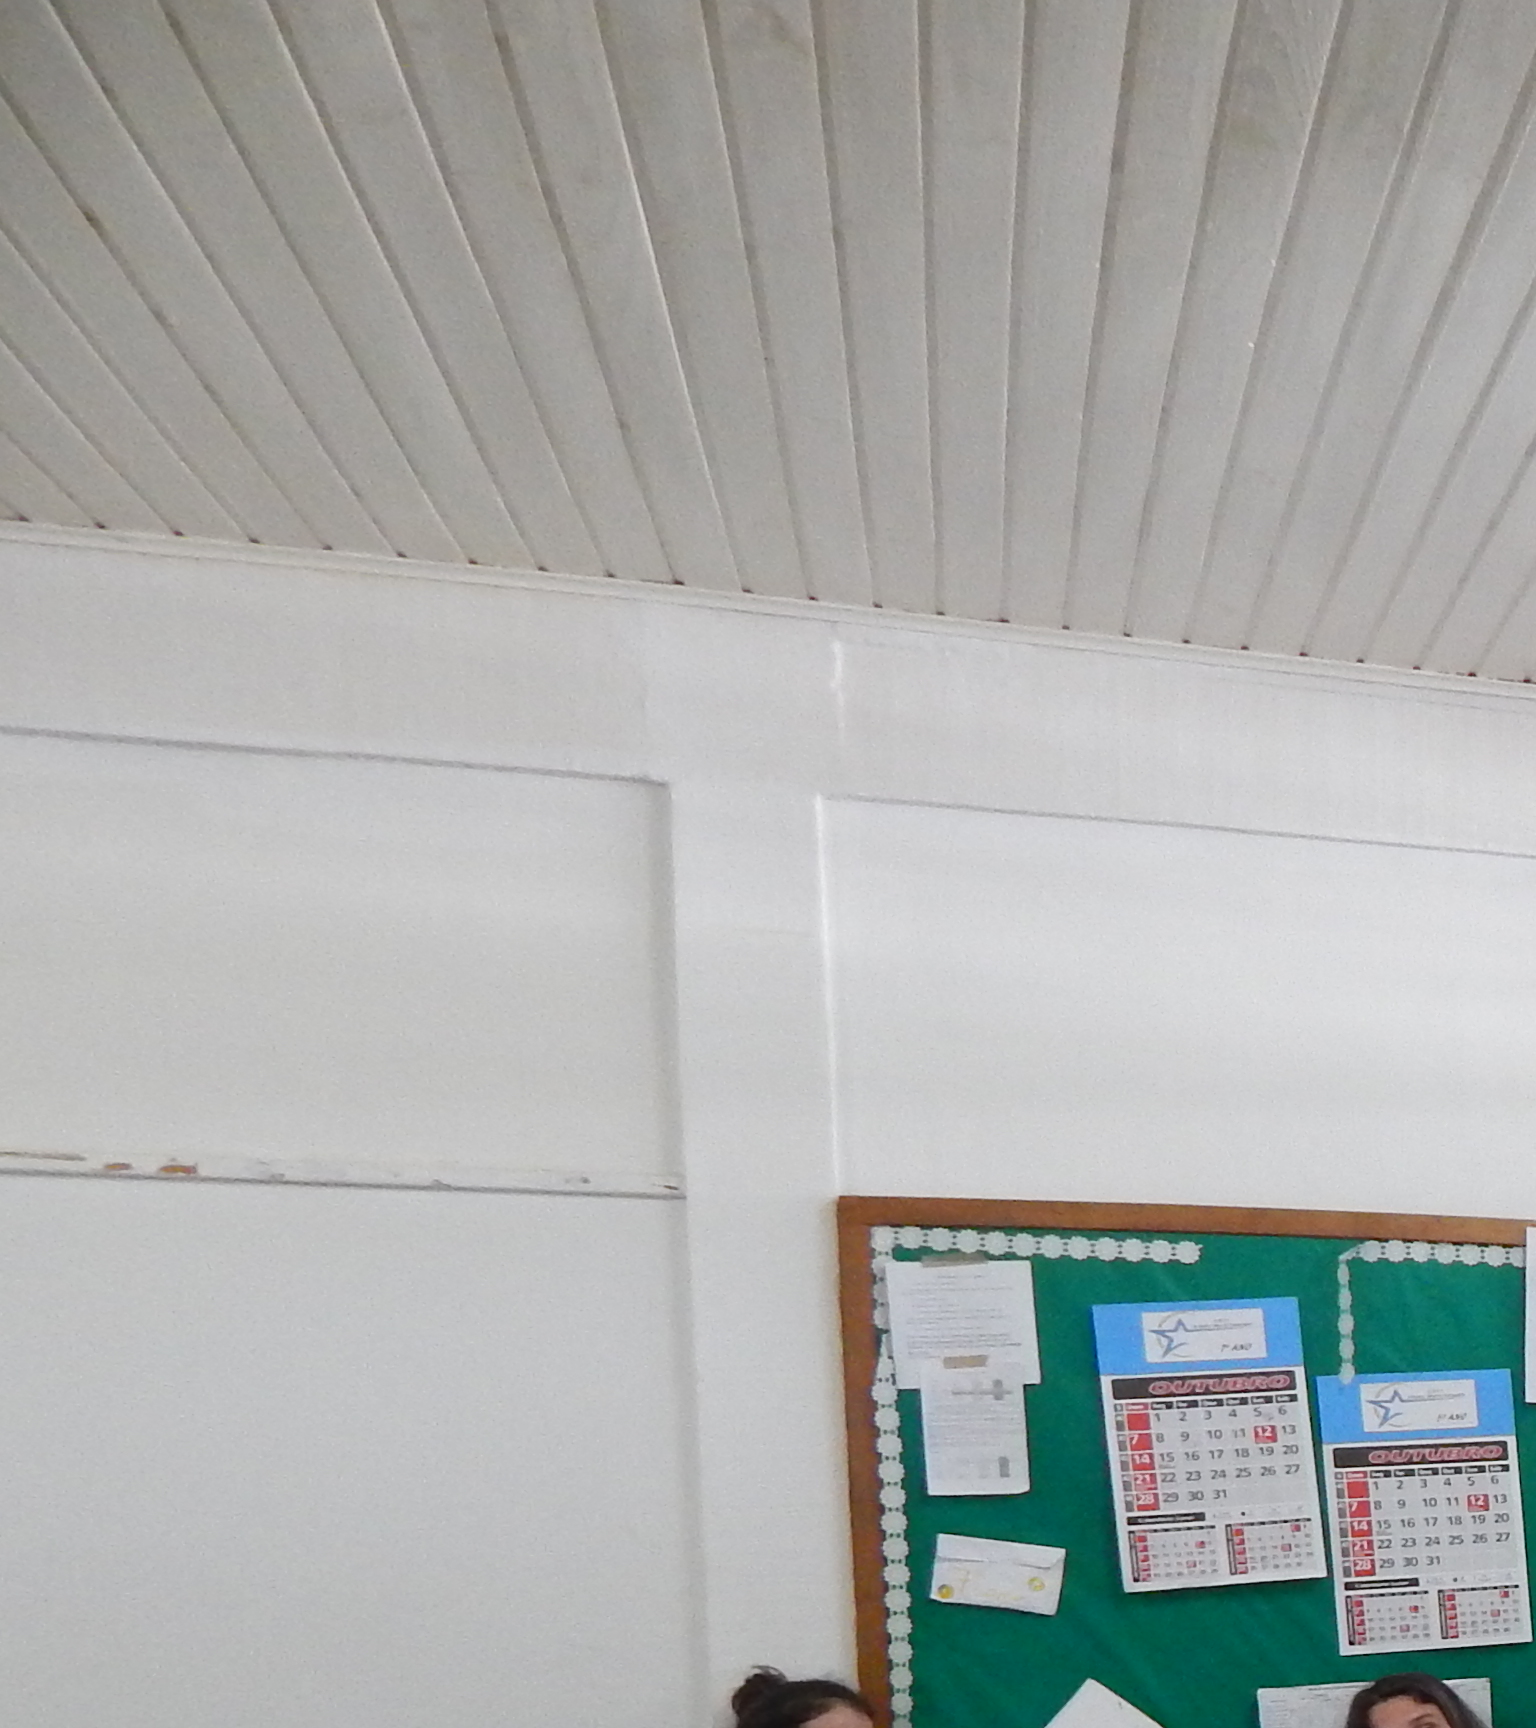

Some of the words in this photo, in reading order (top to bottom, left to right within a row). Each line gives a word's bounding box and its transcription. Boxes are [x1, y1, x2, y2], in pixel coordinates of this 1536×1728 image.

[1149, 1374, 1290, 1395] OUTUBRO
[1155, 1412, 1161, 1422] 1
[1178, 1411, 1187, 1421] 2
[1204, 1410, 1212, 1420] 3
[1229, 1409, 1238, 1419] 4
[1254, 1407, 1262, 1417] 5
[1278, 1406, 1287, 1416] 6
[1130, 1434, 1138, 1444] 7
[1157, 1432, 1165, 1443] 8
[1181, 1431, 1189, 1442] 9
[1207, 1430, 1223, 1440] 10
[1256, 1427, 1272, 1437] 12
[1282, 1425, 1296, 1435] 13
[1134, 1454, 1150, 1464] 14
[1159, 1453, 1175, 1463] 15
[1185, 1451, 1200, 1461] 16
[1209, 1450, 1224, 1460] 17
[1234, 1448, 1250, 1458] 18
[1259, 1447, 1274, 1456] 19
[1282, 1445, 1299, 1455] 20
[1369, 1445, 1503, 1464] OUTUBRO
[1135, 1474, 1150, 1484] 21
[1161, 1473, 1176, 1482] 22
[1186, 1471, 1201, 1481] 23
[1210, 1470, 1227, 1479] 24
[1235, 1468, 1251, 1478] 25
[1260, 1466, 1276, 1476] 26
[1284, 1464, 1300, 1474] 27
[1373, 1481, 1379, 1490] 1
[1396, 1480, 1404, 1489] 2
[1420, 1479, 1428, 1488] 3
[1443, 1477, 1452, 1487] 4
[1467, 1476, 1475, 1486] 5
[1491, 1475, 1499, 1484] 6
[1139, 1494, 1155, 1504] 28
[1163, 1492, 1179, 1502] 29
[1188, 1491, 1204, 1501] 30
[1213, 1489, 1227, 1499] 31
[1350, 1502, 1358, 1511] 7
[1374, 1501, 1382, 1510] 8
[1398, 1499, 1406, 1509] 9
[1422, 1498, 1437, 1507] 10
[1470, 1495, 1484, 1505] 12
[1493, 1494, 1507, 1503] 13
[1352, 1521, 1368, 1531] 14
[1377, 1520, 1391, 1529] 15
[1400, 1518, 1415, 1528] 16
[1424, 1517, 1438, 1527] 17
[1449, 1516, 1463, 1525] 18
[1471, 1514, 1486, 1524] 19
[1494, 1513, 1510, 1523] 20
[1353, 1540, 1368, 1550] 21
[1377, 1539, 1392, 1549] 22
[1401, 1538, 1416, 1547] 23
[1425, 1536, 1440, 1546] 24
[1449, 1535, 1464, 1545] 25
[1472, 1533, 1488, 1543] 26
[1495, 1532, 1510, 1542] 27
[1355, 1560, 1371, 1570] 28
[1379, 1558, 1395, 1568] 29
[1402, 1557, 1418, 1566] 30
[1426, 1555, 1440, 1565] 31
